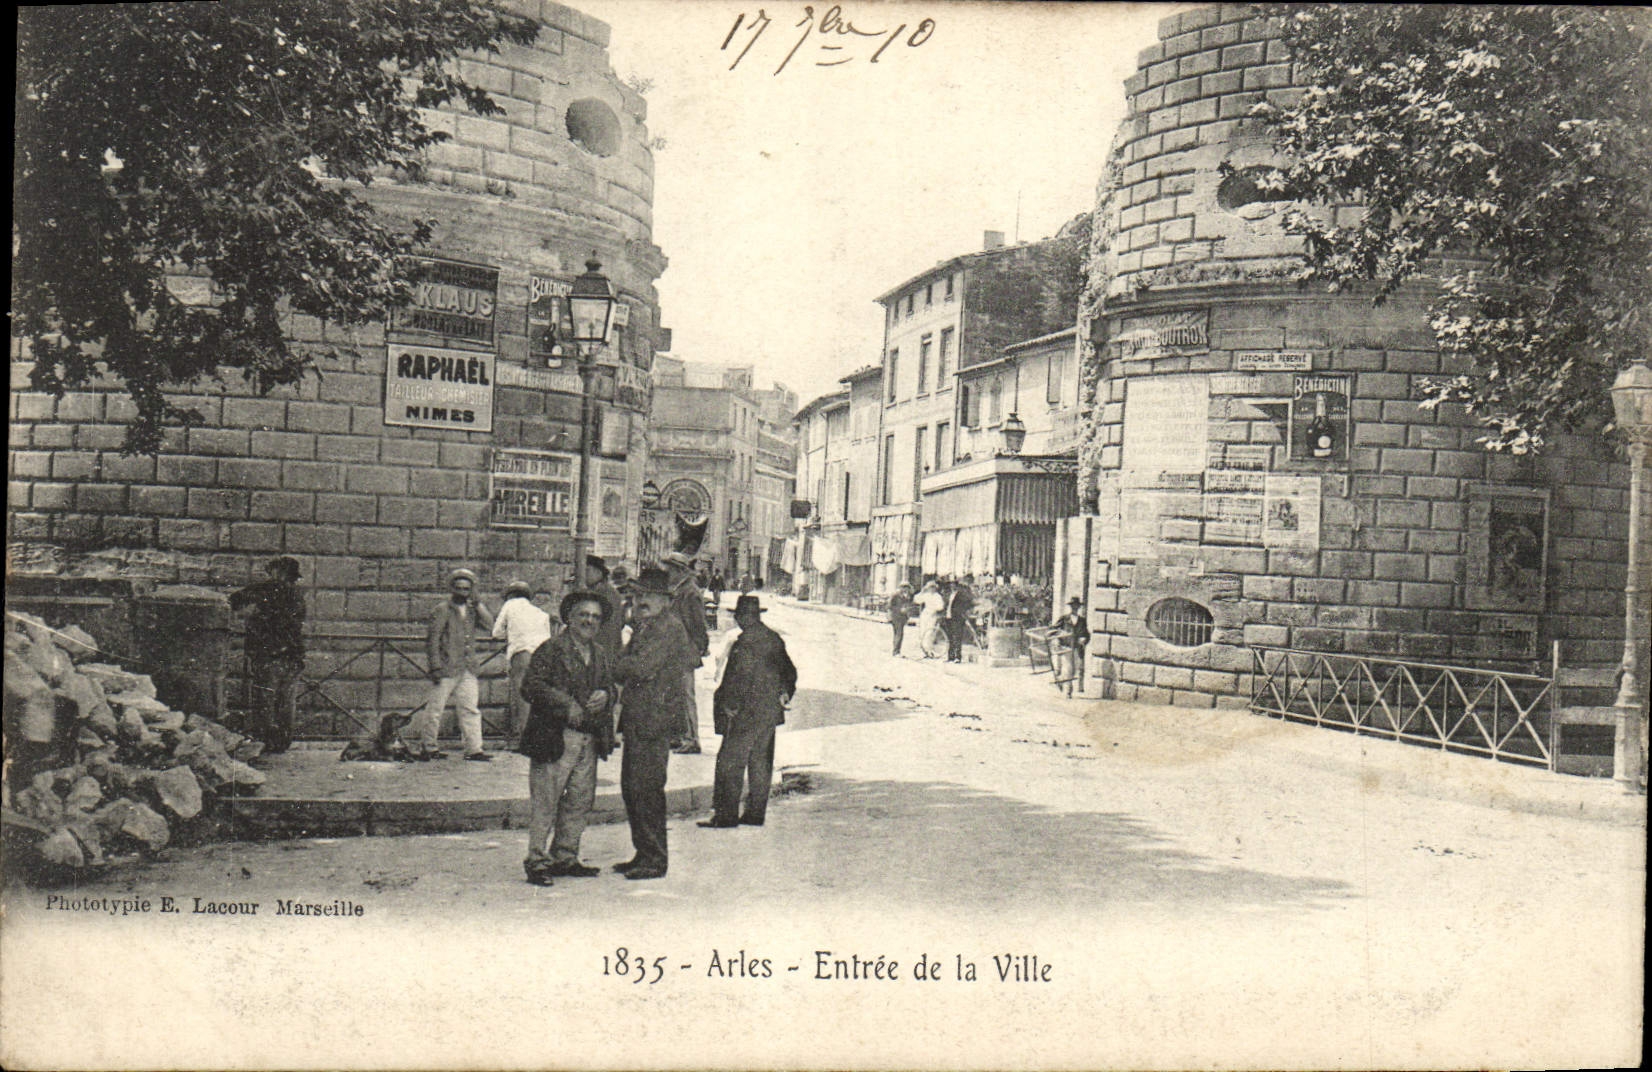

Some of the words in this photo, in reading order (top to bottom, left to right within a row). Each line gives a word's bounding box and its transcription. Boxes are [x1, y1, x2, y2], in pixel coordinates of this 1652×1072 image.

[720, 9, 771, 71] 17
[418, 282, 493, 317] KLAUS
[397, 353, 490, 386] RAPHAËL
[406, 405, 475, 423] NIMES
